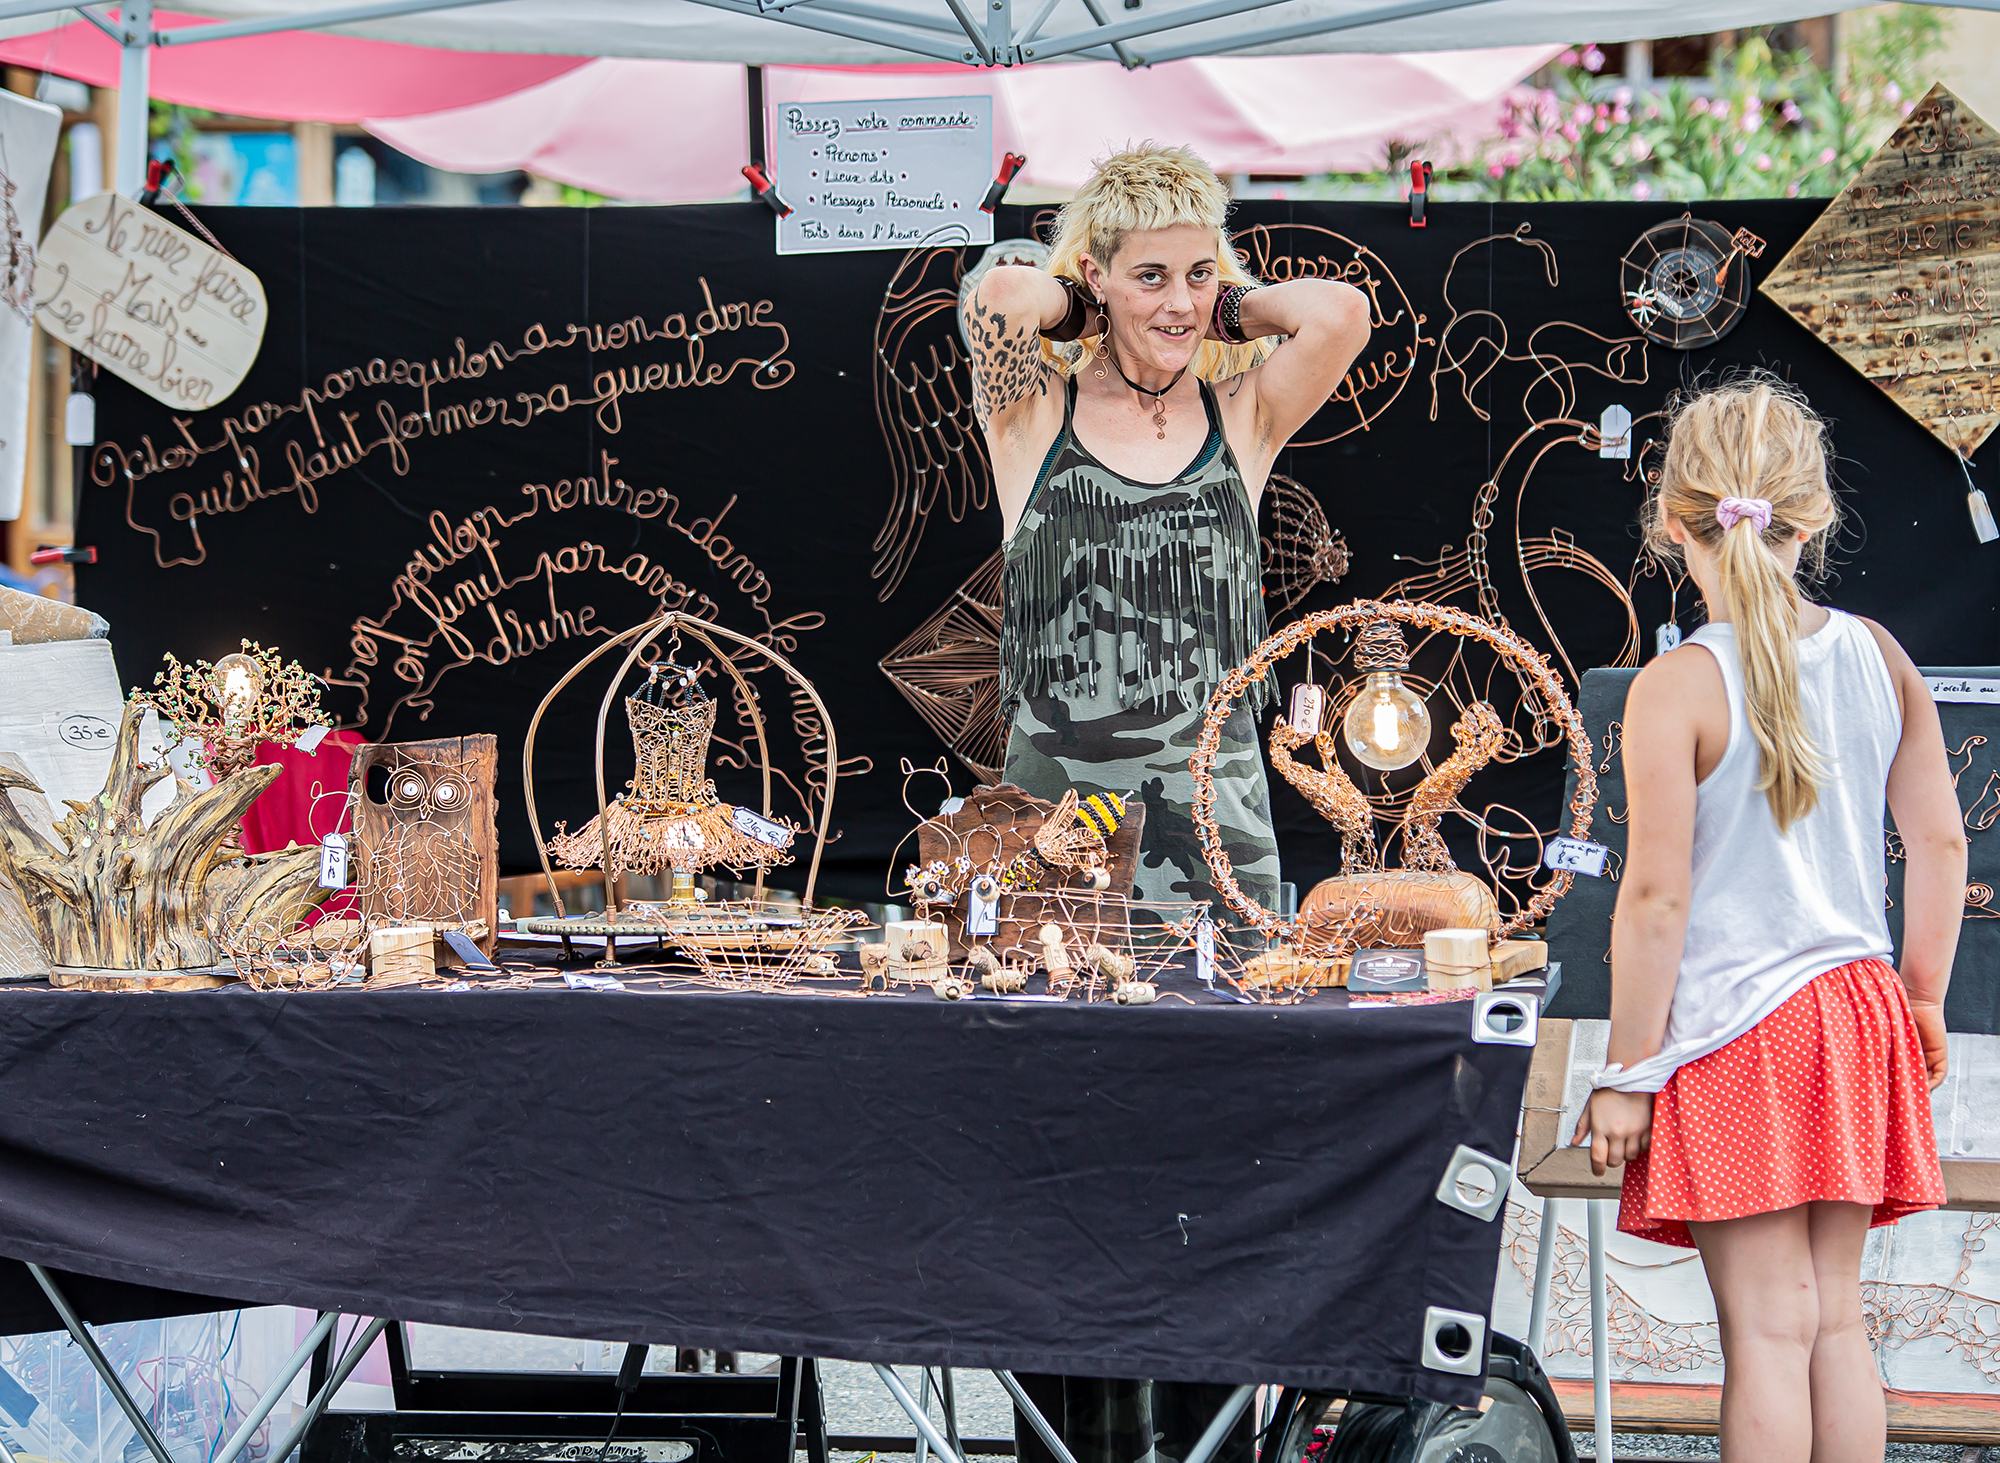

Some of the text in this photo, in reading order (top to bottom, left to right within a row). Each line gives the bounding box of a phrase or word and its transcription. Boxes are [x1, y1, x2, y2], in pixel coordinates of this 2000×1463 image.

[786, 107, 841, 139] Passez
[857, 111, 889, 129] votre
[822, 189, 945, 214] Messages Personnels
[1895, 165, 2000, 208] savaie
[800, 220, 830, 240] Faits
[838, 223, 864, 239] dans
[1883, 224, 1942, 283] que
[178, 252, 257, 326] faire
[148, 335, 214, 408] bien
[1557, 850, 1566, 865] 8
[1585, 847, 1601, 857] pot
